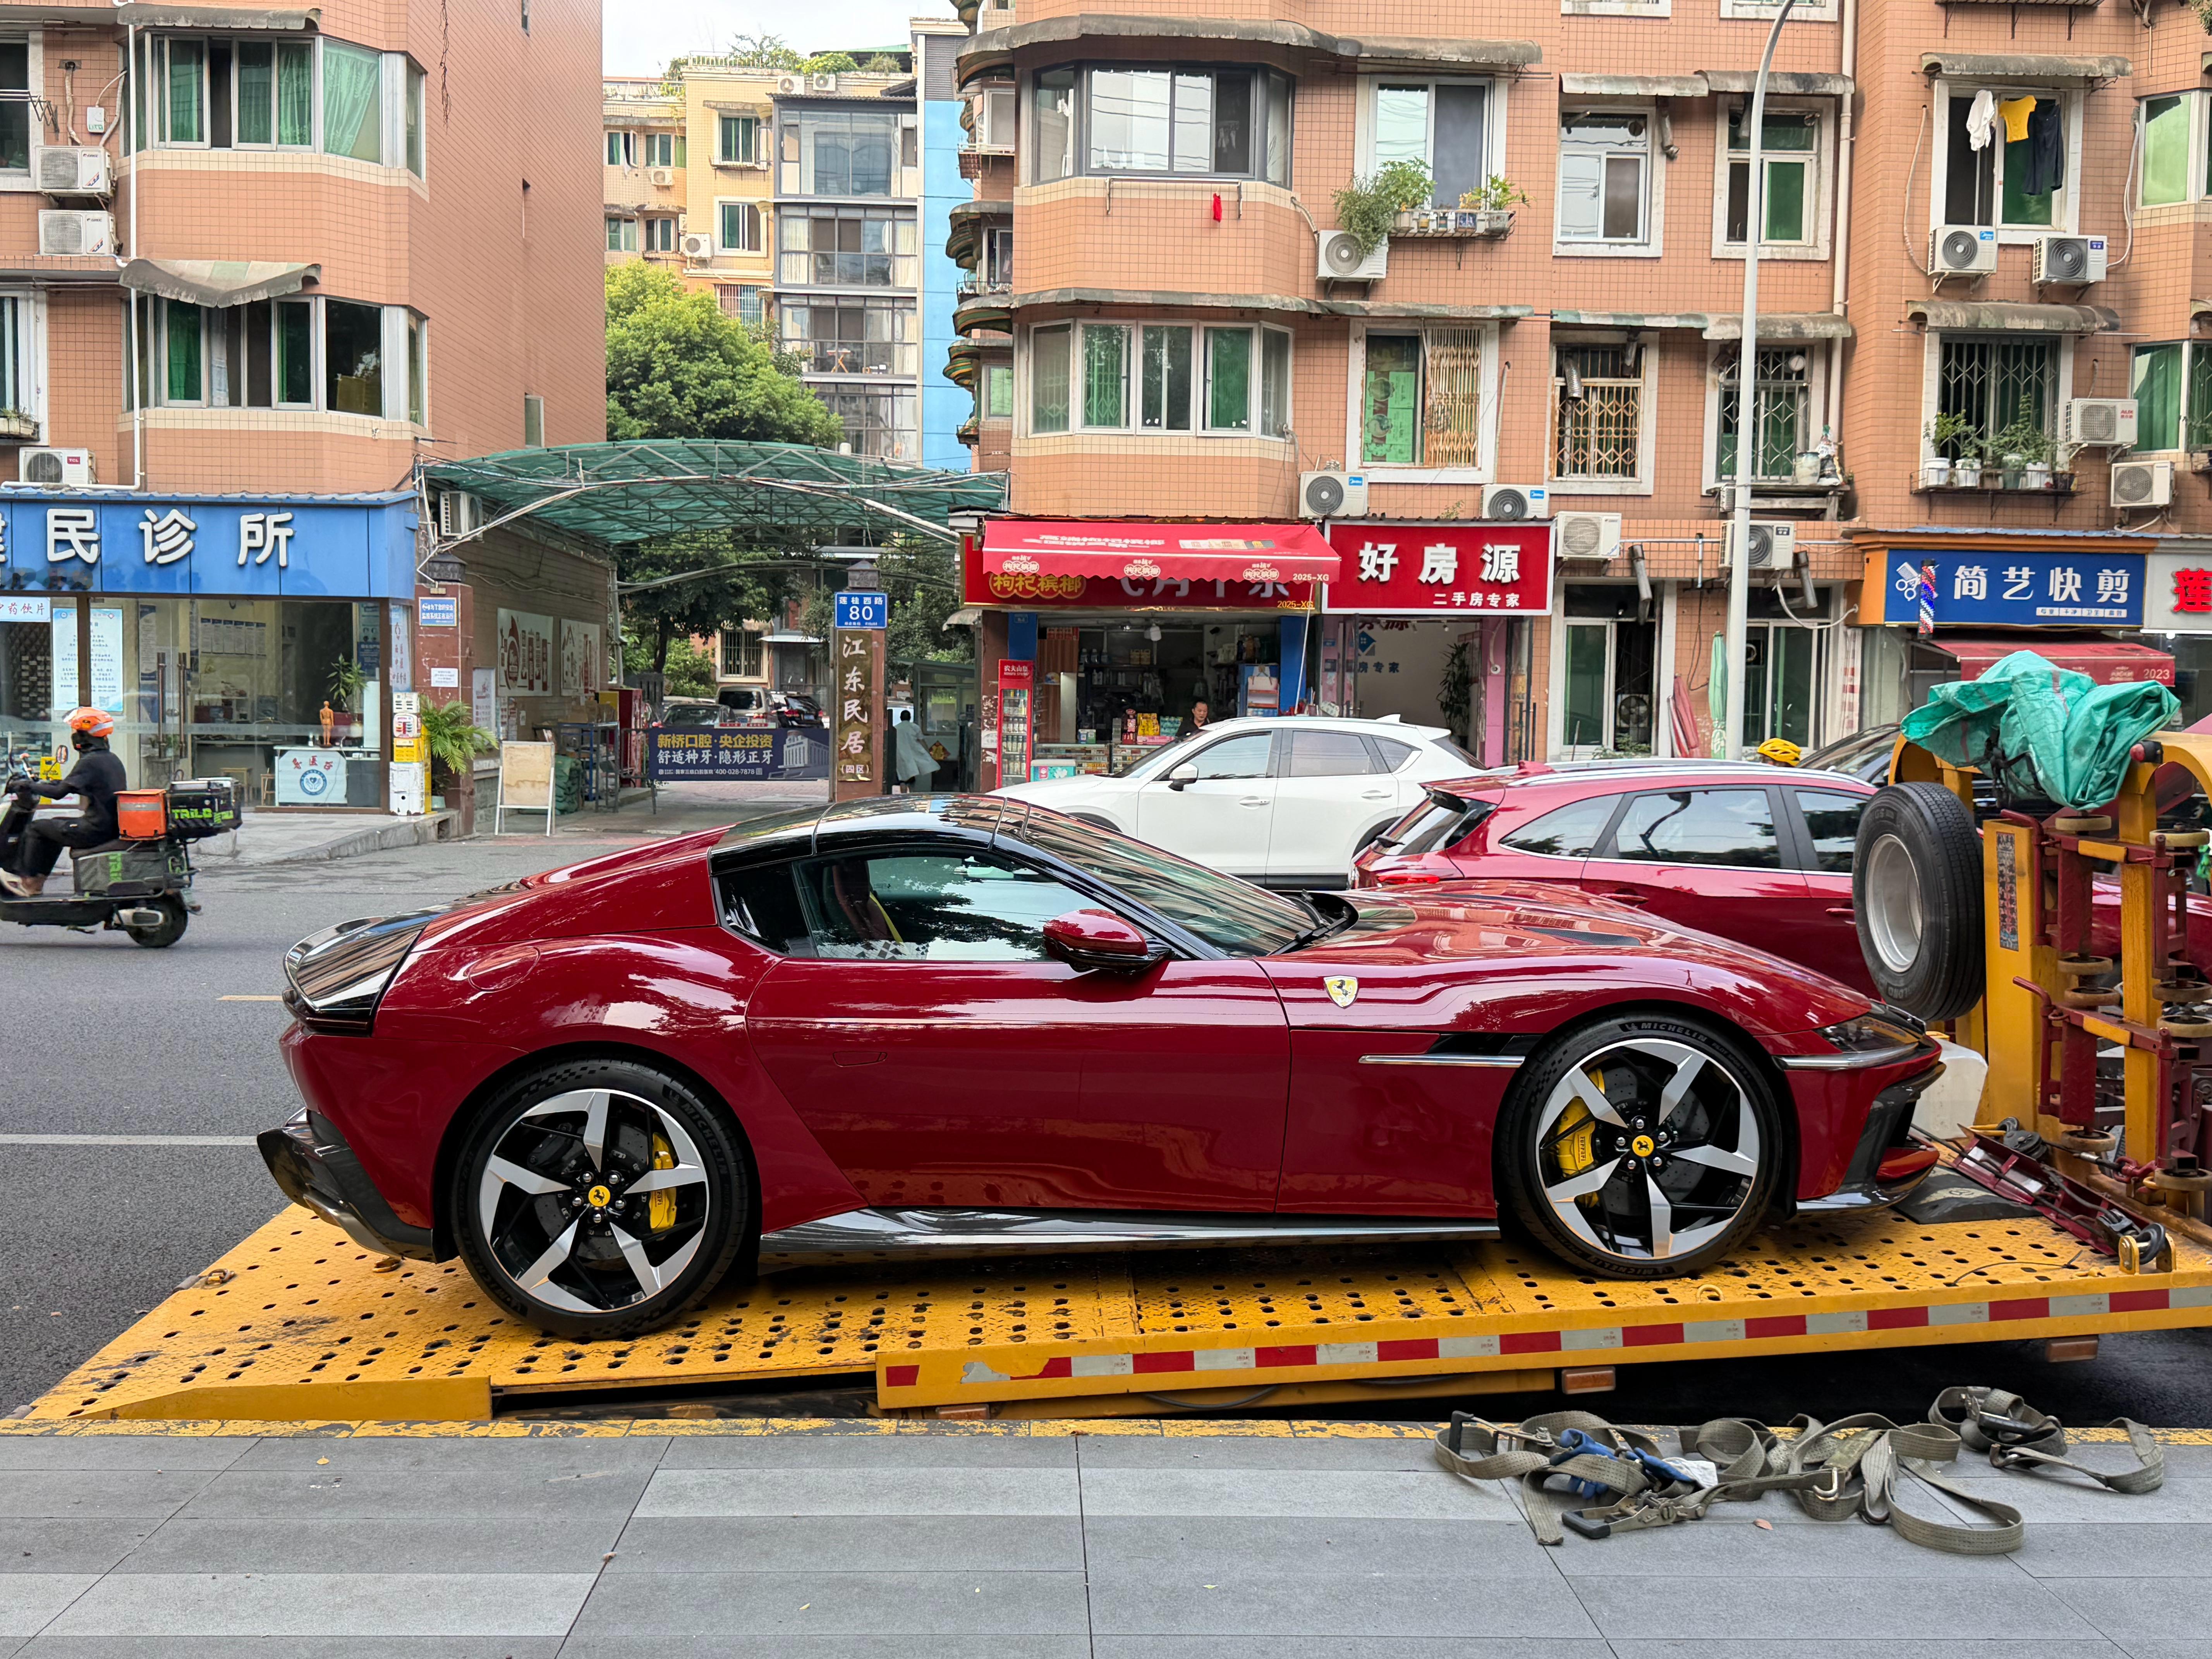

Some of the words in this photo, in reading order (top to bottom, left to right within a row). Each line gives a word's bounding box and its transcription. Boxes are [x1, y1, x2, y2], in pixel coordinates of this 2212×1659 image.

[0, 508, 294, 567] 民诊所
[1357, 541, 1521, 585] 好房源
[993, 574, 1082, 593] 枸杞槟榔
[1293, 573, 1329, 581] 2025-XG
[1954, 565, 2130, 604] 简艺快剪
[839, 596, 883, 605] 莲桂西路
[1277, 600, 1314, 608] 2025-XG
[1433, 592, 1520, 608] 二手房专家
[849, 606, 873, 620] 80
[2143, 668, 2170, 680] 2023
[840, 635, 869, 754] 江东民居
[658, 733, 773, 749] 新桥口腔·央企投资
[657, 749, 773, 765] 舒适种牙·隐形正牙
[1641, 1022, 1708, 1042] MICHELIN
[681, 1102, 728, 1174] MICHELIN
